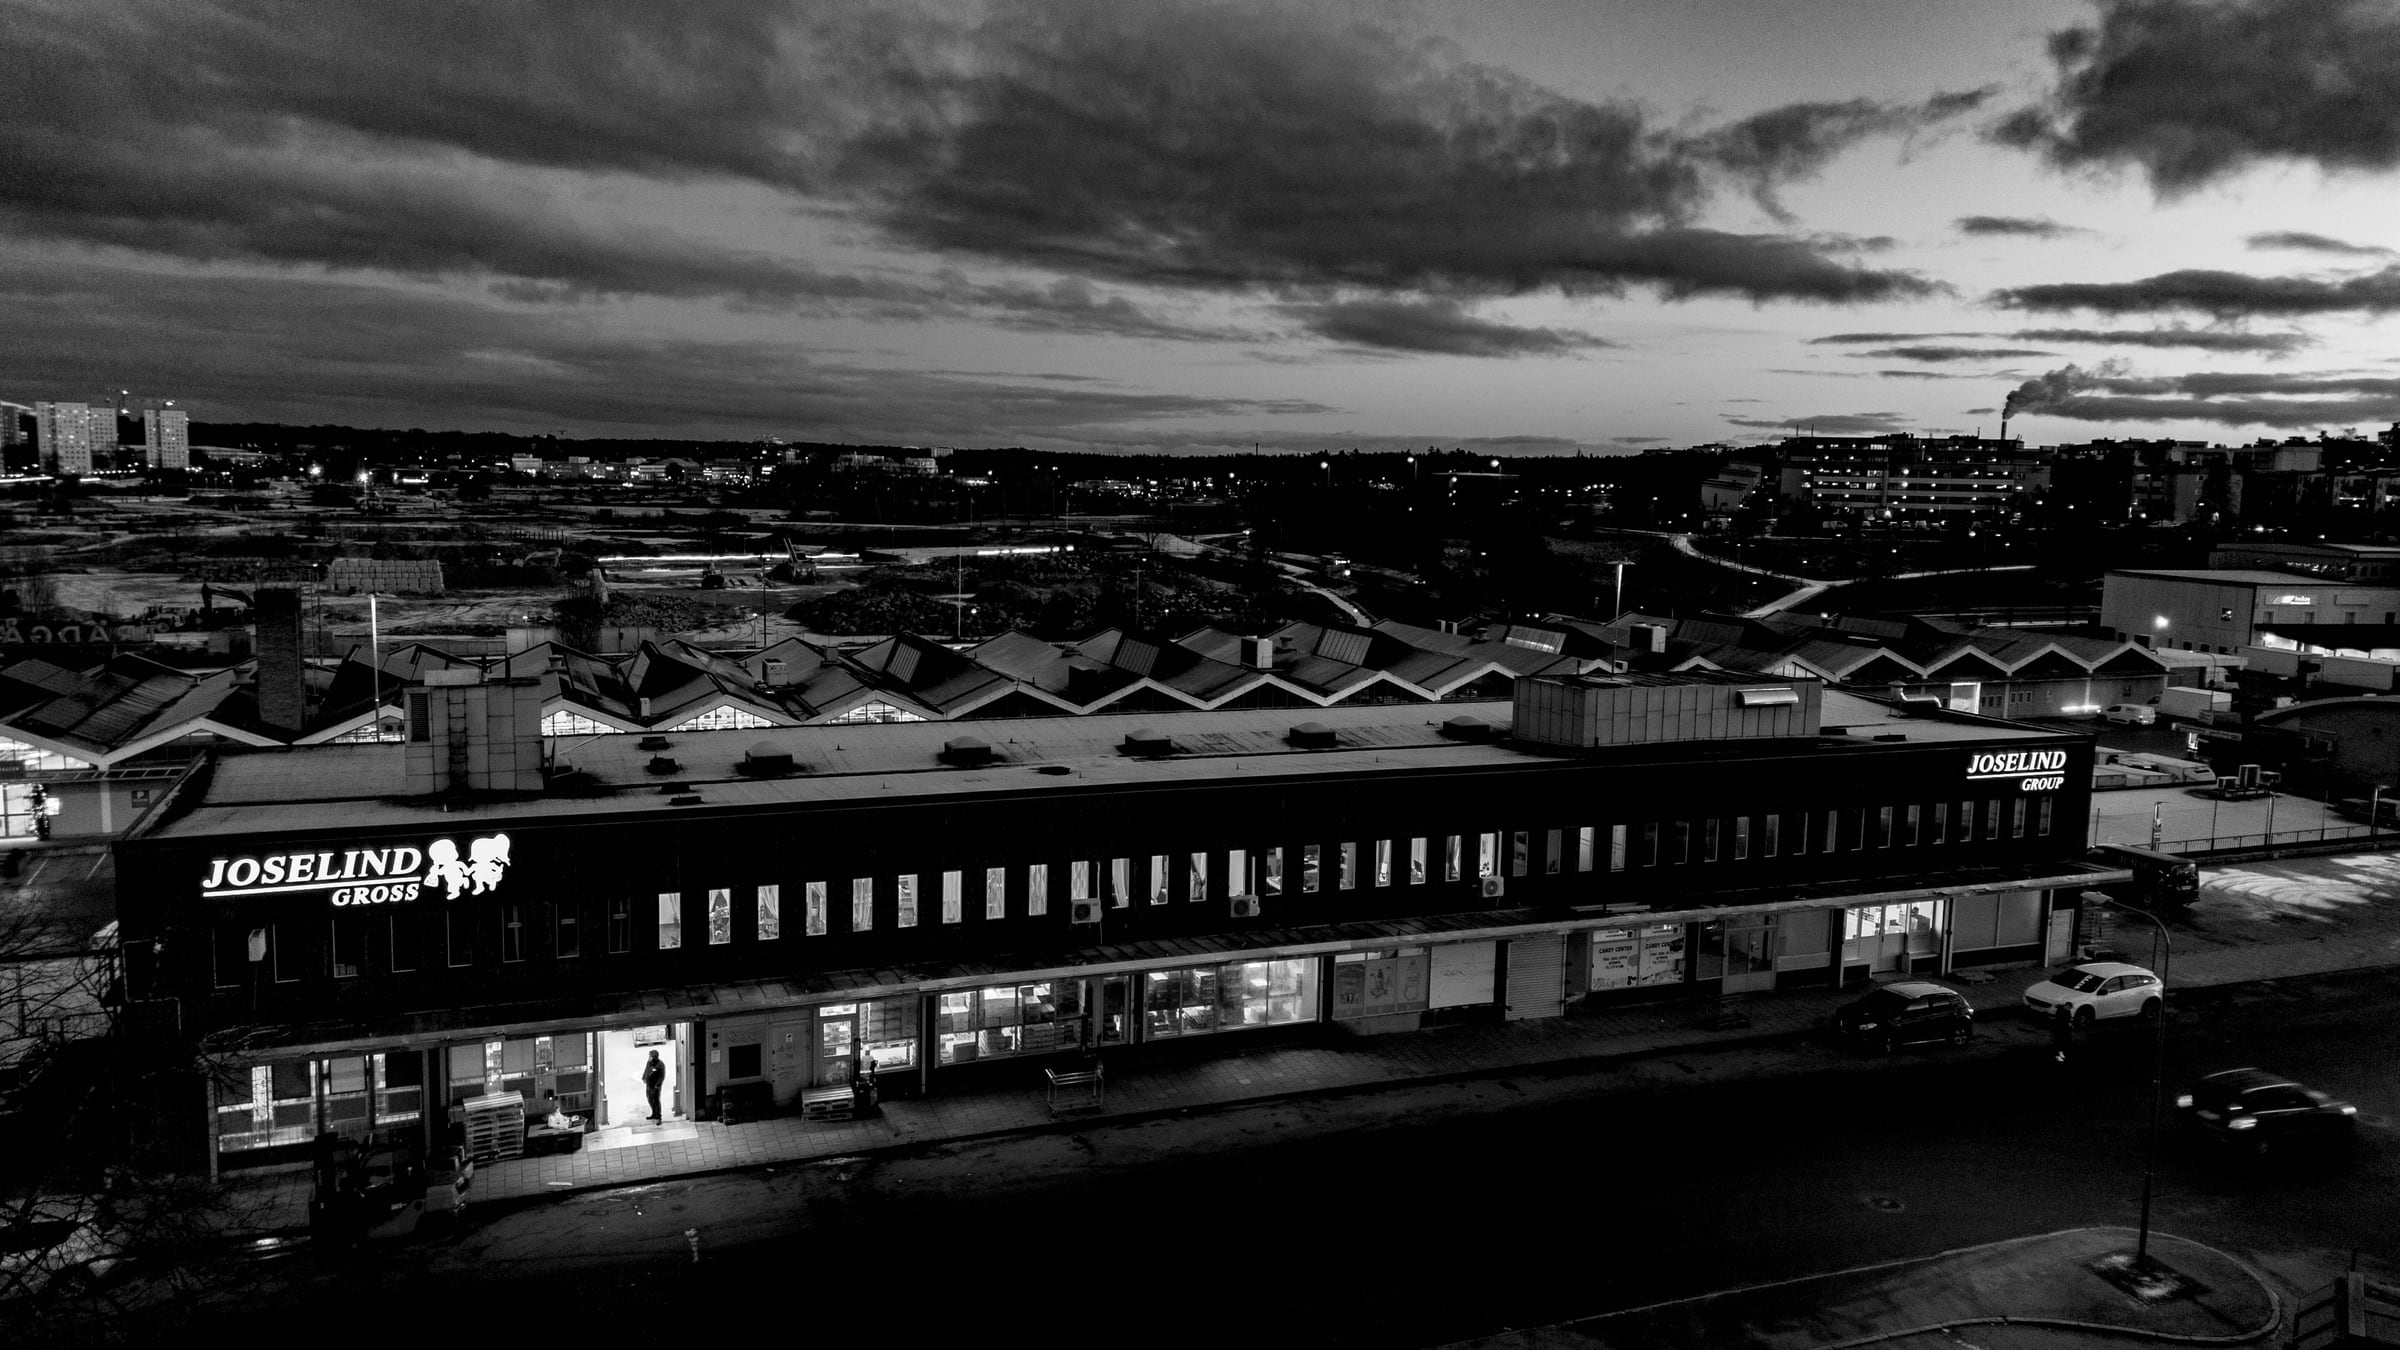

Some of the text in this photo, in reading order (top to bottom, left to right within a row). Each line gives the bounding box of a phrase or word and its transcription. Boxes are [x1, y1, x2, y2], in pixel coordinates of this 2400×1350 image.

[1967, 751, 2067, 774] JOSELIND
[2020, 776, 2065, 791] GROUP
[201, 847, 422, 889] JOSELIND
[331, 883, 420, 907] GROSS
[1615, 945, 1632, 953] CENTER
